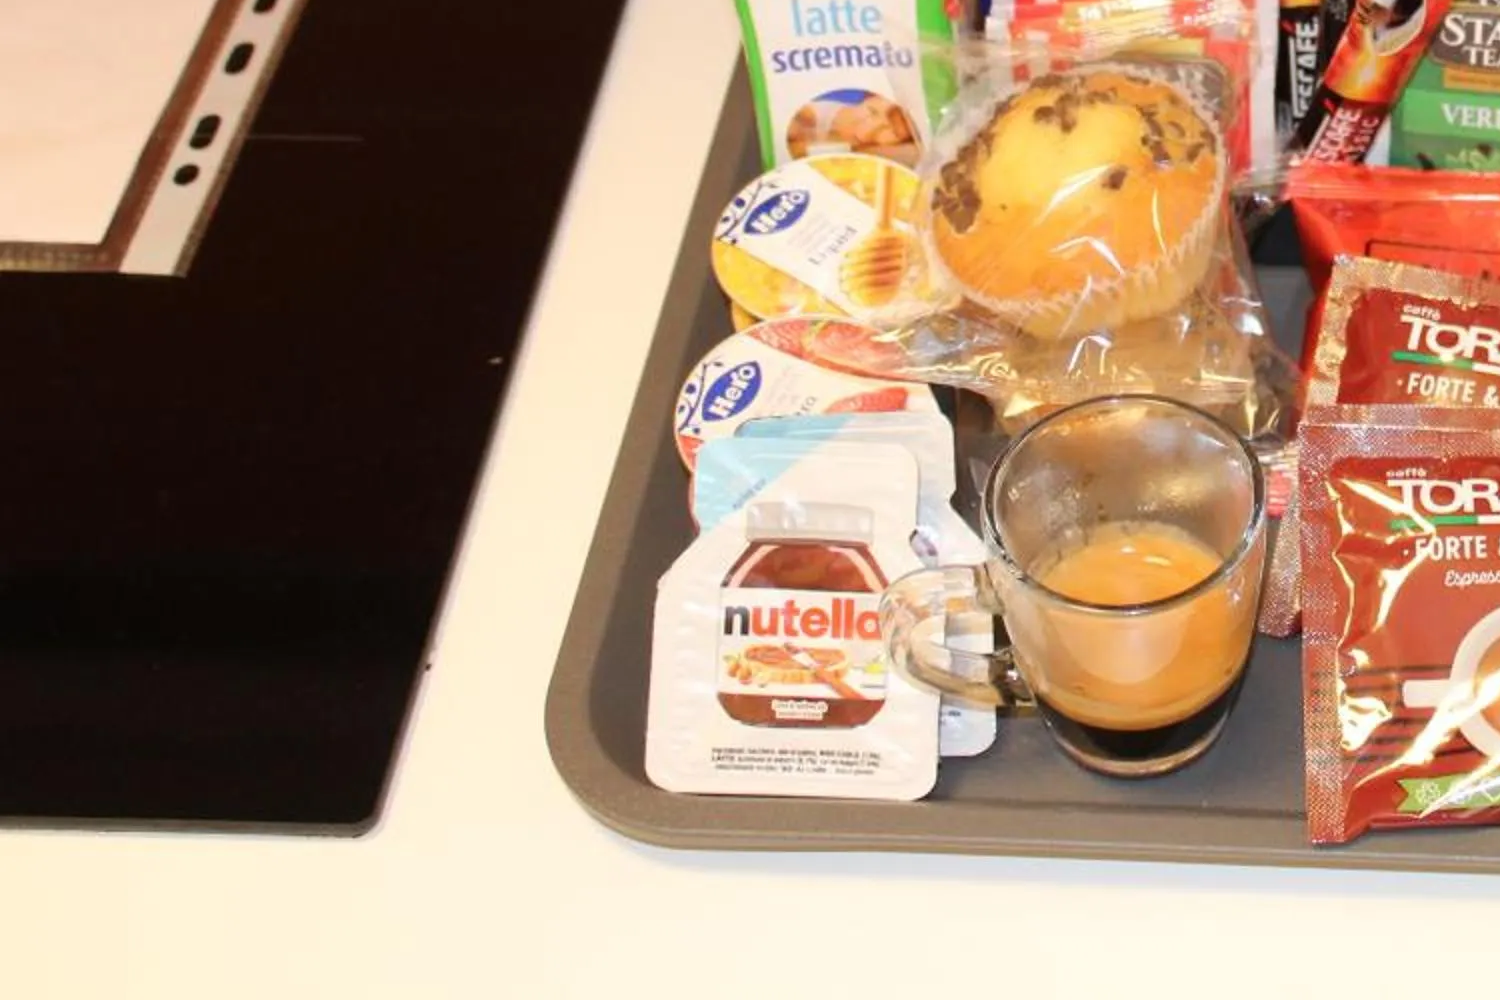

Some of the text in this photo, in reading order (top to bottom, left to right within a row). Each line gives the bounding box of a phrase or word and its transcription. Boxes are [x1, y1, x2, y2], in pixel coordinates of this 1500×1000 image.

[772, 41, 914, 74] scremato
[752, 191, 804, 234] Hero
[711, 362, 757, 418] Hero
[1407, 372, 1477, 402] FORTE
[1484, 384, 1500, 407] &
[1414, 534, 1488, 561] FORTE
[723, 597, 883, 640] nutella
